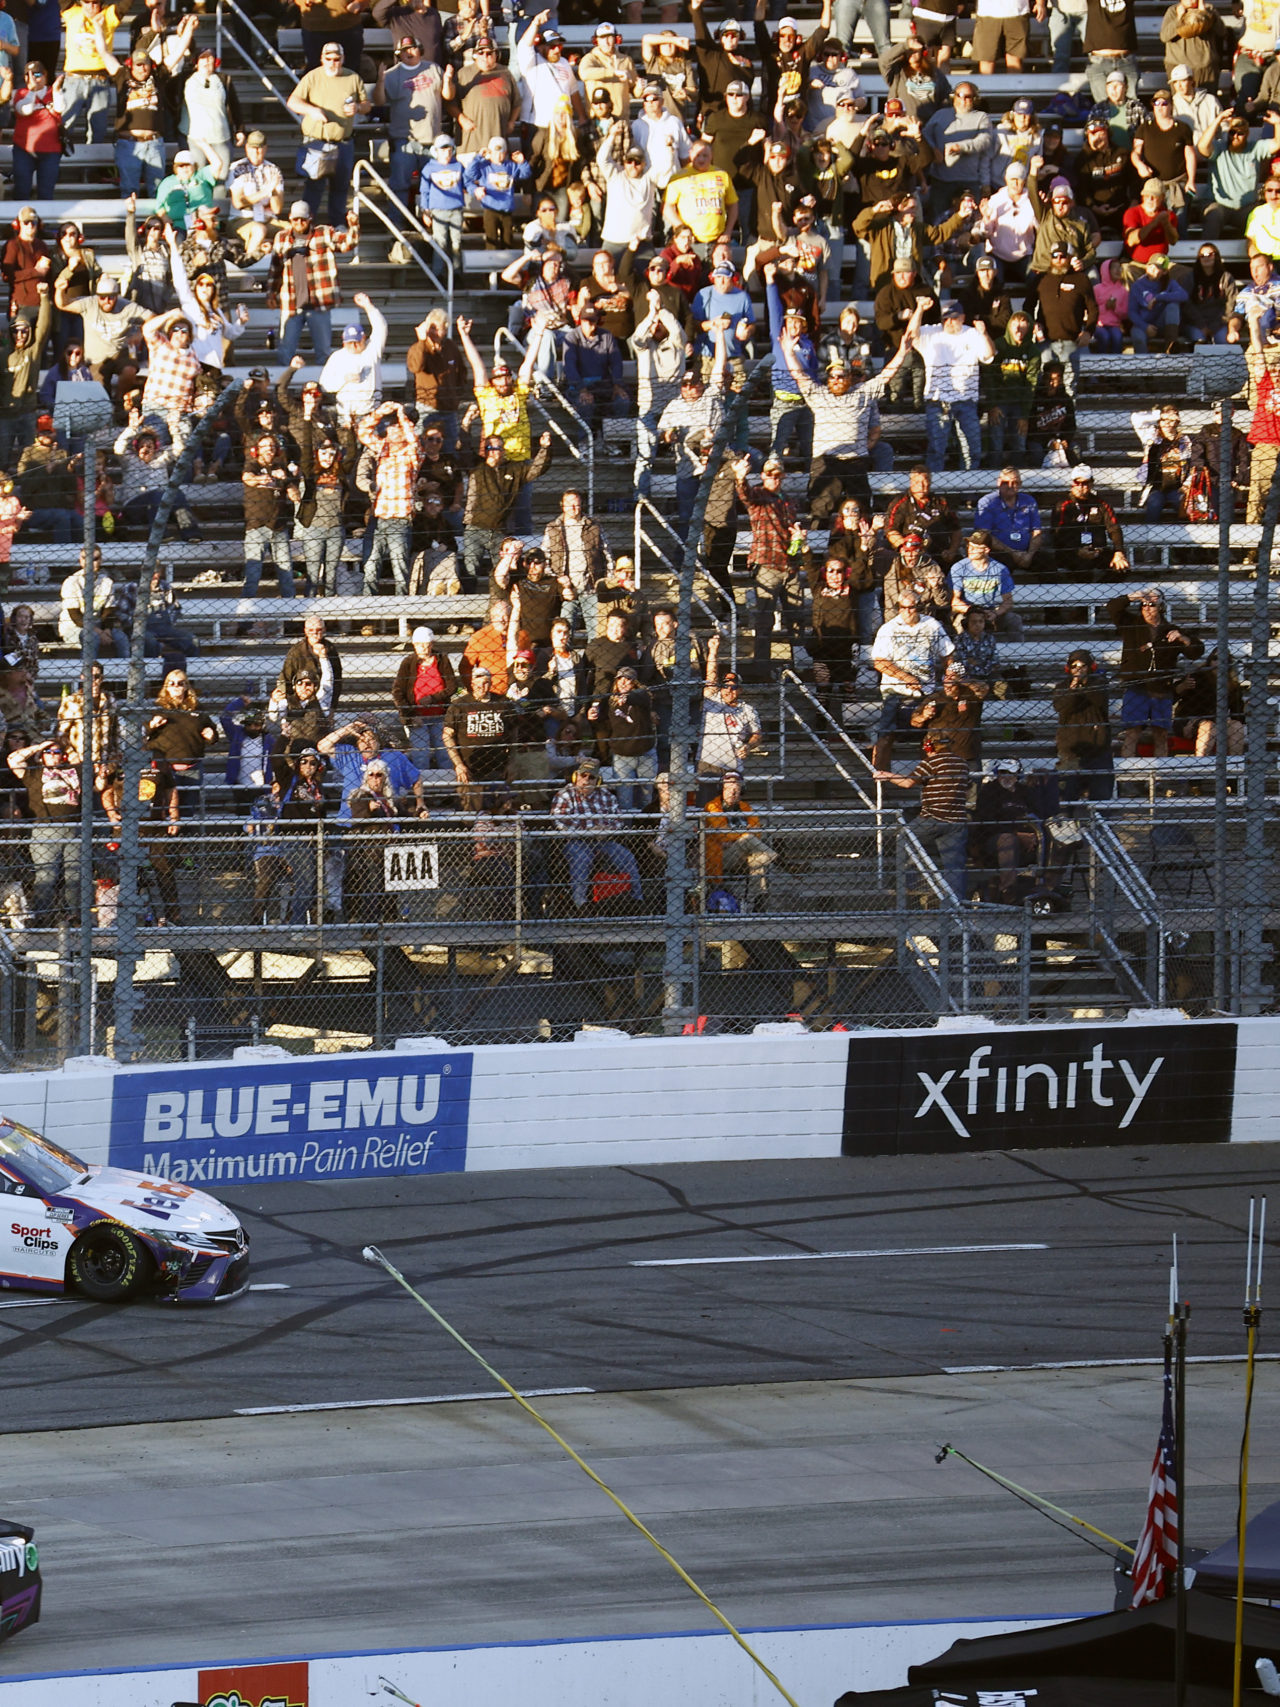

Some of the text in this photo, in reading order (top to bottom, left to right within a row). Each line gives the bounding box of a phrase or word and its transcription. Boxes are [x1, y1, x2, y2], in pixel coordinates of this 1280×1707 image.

[467, 712, 502, 724] FUCK
[467, 723, 504, 734] BIDEN
[390, 850, 433, 881] AAA
[913, 1041, 1166, 1139] xfinity
[143, 1073, 442, 1144] BLUE-EMU
[143, 1130, 439, 1184] Maximum Pain Relief
[11, 1223, 52, 1239] Sport
[13, 1246, 57, 1257] HAIRCUTS
[24, 1236, 59, 1251] Clips
